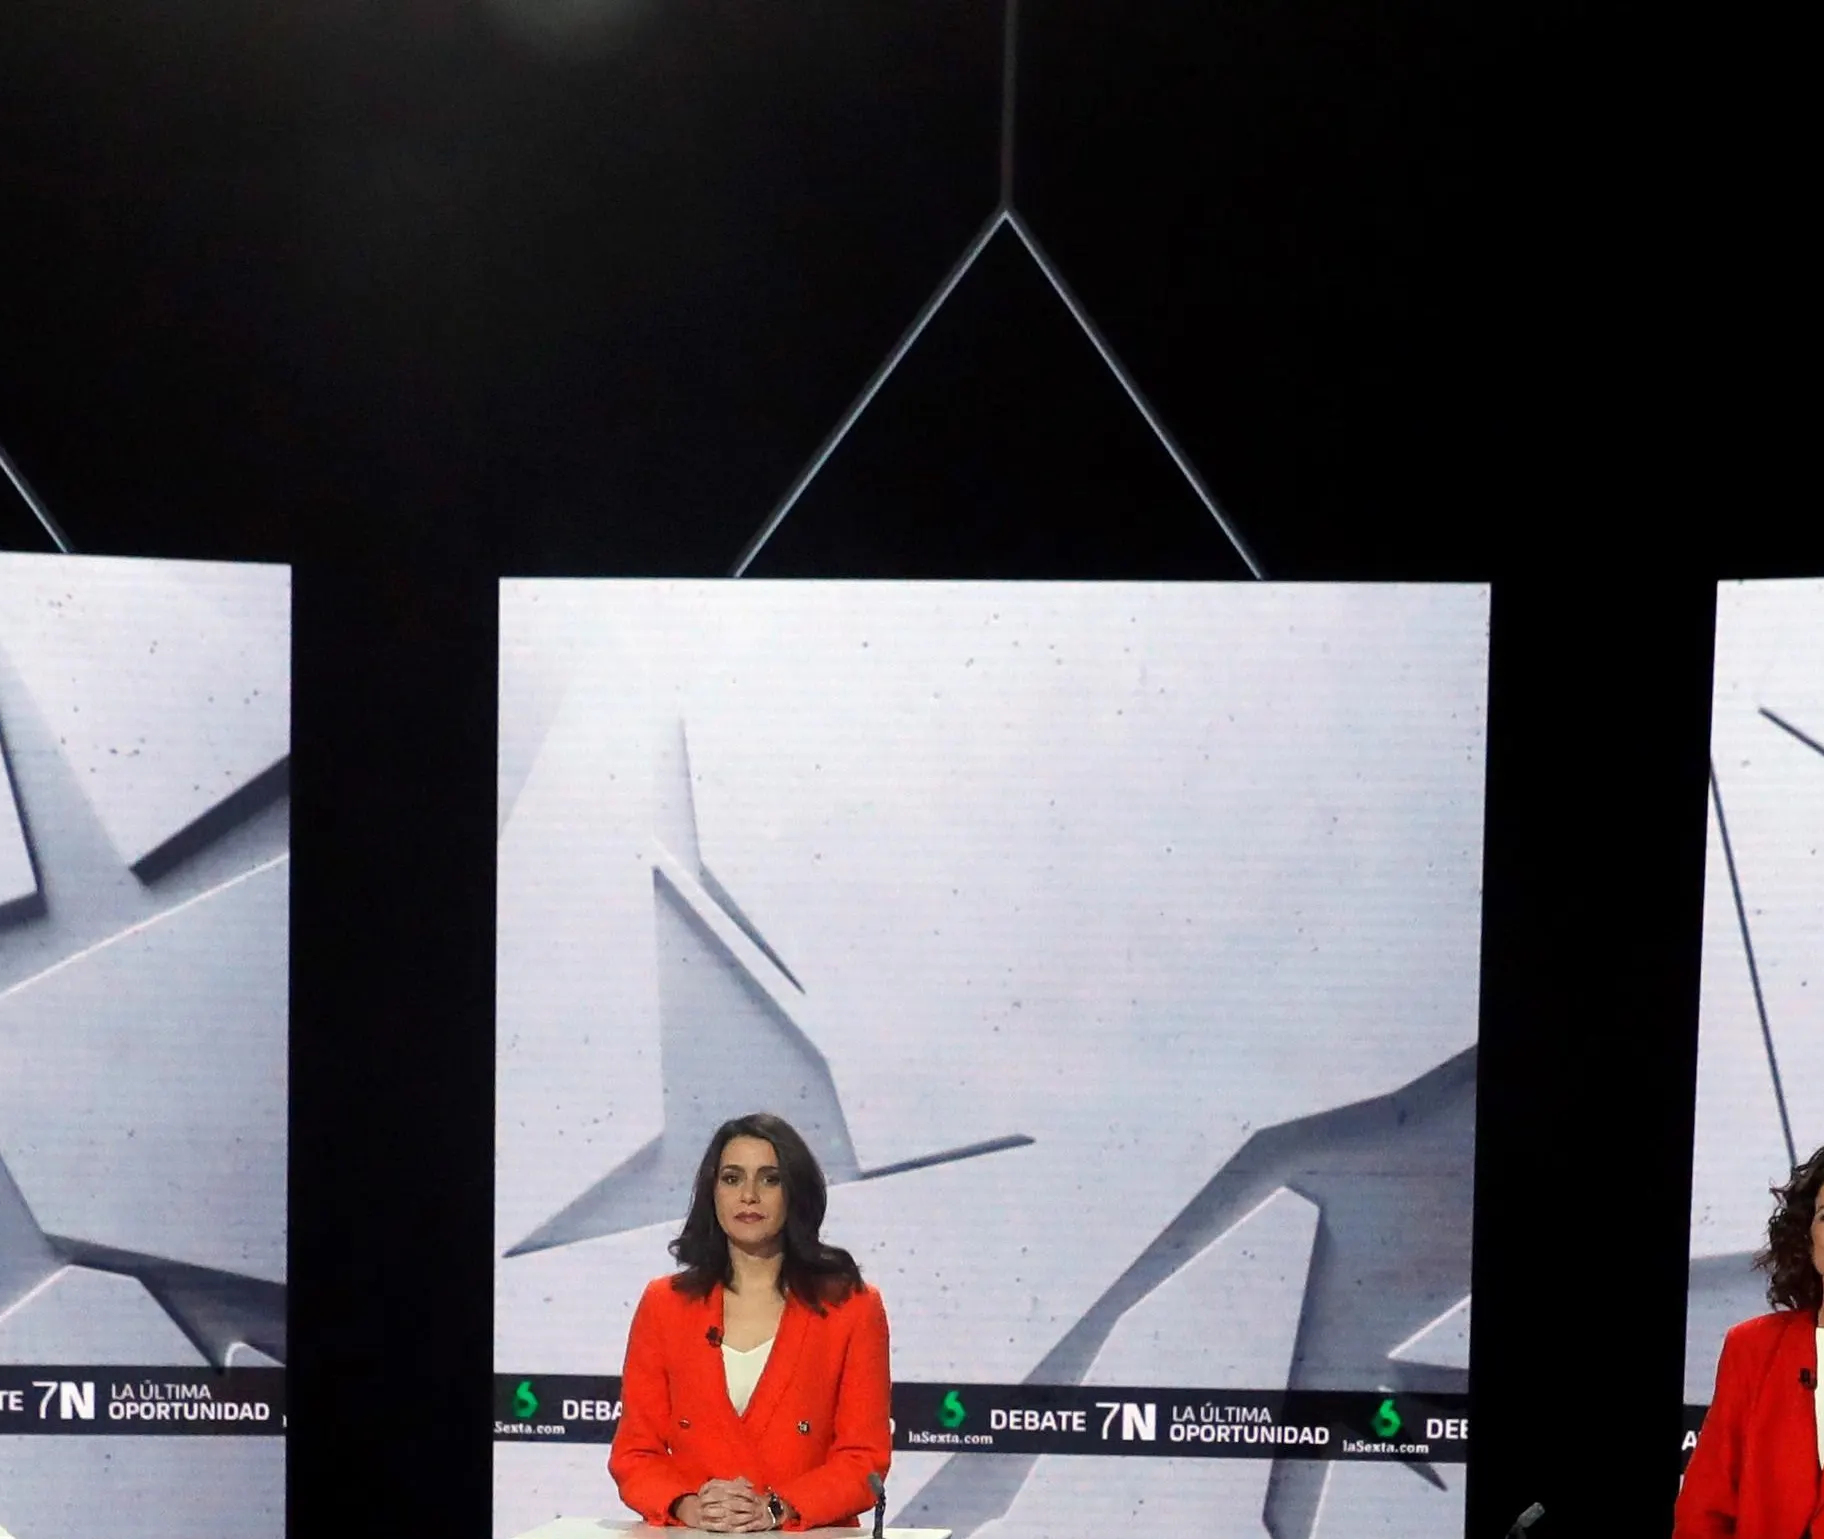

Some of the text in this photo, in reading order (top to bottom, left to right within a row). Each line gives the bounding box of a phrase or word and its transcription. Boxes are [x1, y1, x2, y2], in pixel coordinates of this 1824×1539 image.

[111, 1379, 212, 1400] LA ÚLTIMA
[32, 1381, 95, 1420] 7N
[108, 1402, 271, 1420] OPORTUNIDAD
[990, 1402, 1156, 1441] DEBATE 7N
[1173, 1402, 1272, 1423] LA ÚLTIMA
[908, 1431, 993, 1444] laSexta.com
[1170, 1424, 1330, 1445] OPORTUNIDAD
[1343, 1440, 1429, 1453] laSexta.com
